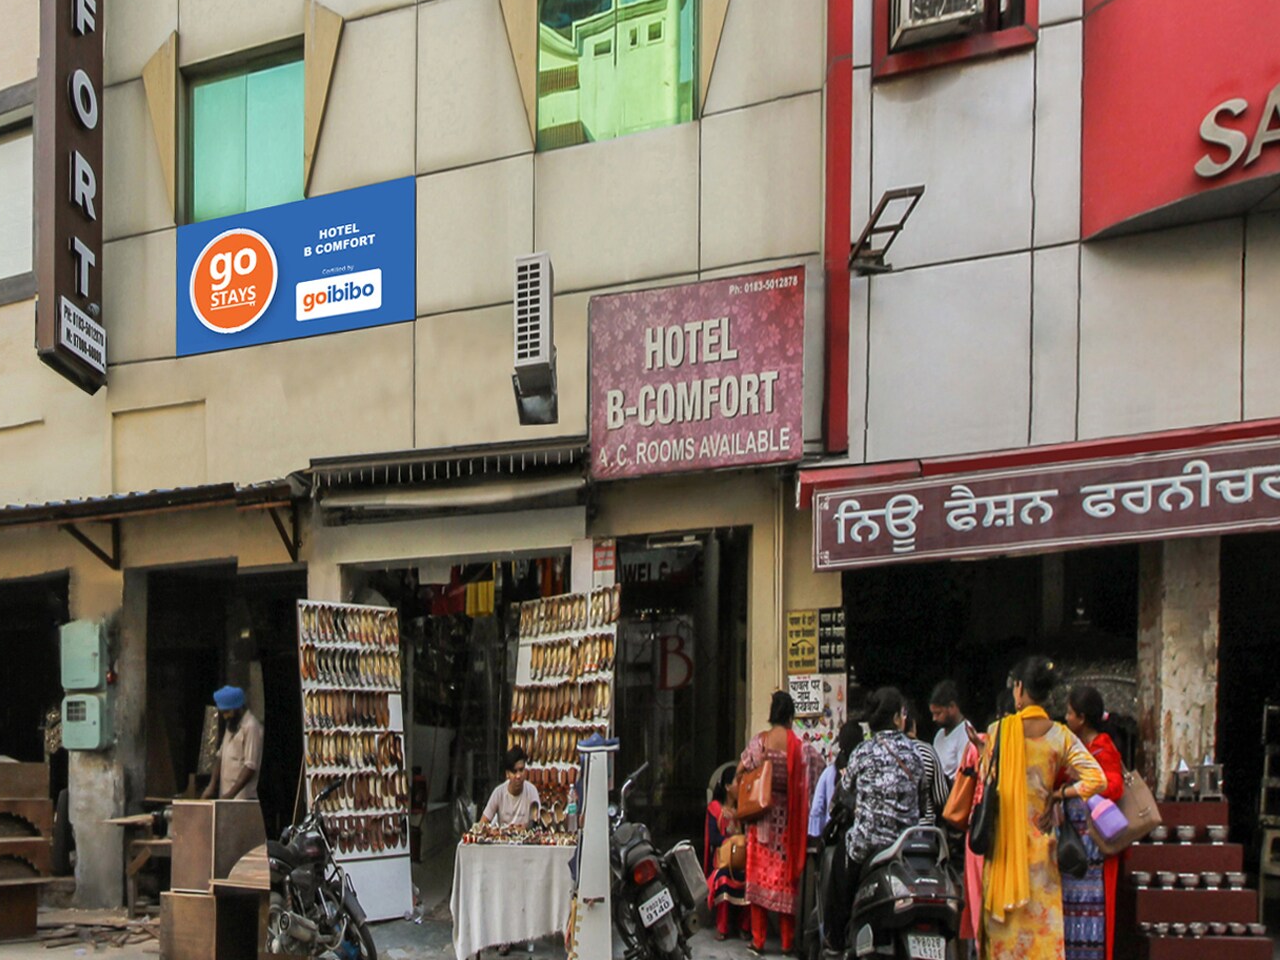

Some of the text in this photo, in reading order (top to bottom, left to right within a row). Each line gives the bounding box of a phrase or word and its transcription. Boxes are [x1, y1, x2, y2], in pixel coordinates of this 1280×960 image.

[304, 234, 376, 257] B COMFORT
[319, 223, 360, 240] HOTEL
[209, 248, 257, 291] go
[729, 276, 798, 296] Ph: 0183-5012878
[210, 285, 257, 307] STAYS
[303, 283, 375, 312] goibibo
[645, 317, 738, 370] HOTEL
[607, 371, 779, 430] B-COMFORT
[637, 437, 695, 465] ROOMS
[699, 427, 790, 459] AVAILABLE
[833, 494, 924, 553] ਨਿਊ
